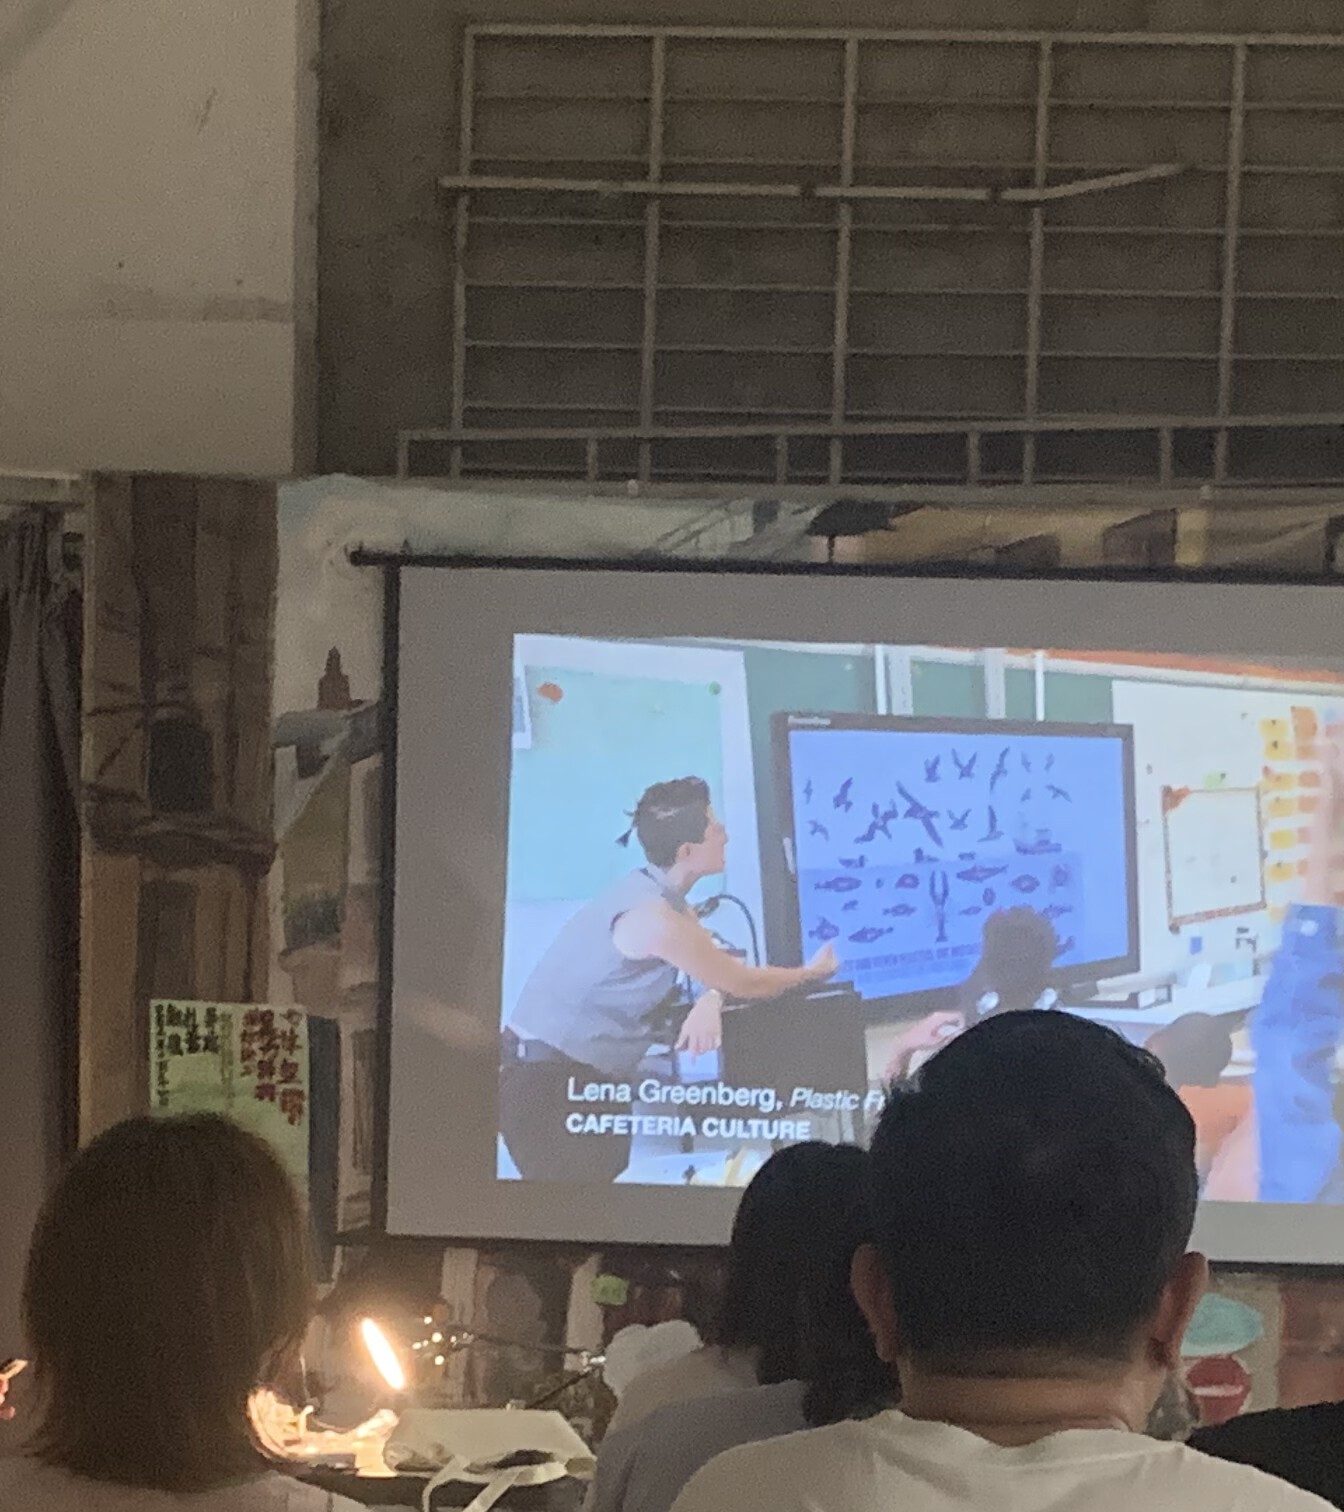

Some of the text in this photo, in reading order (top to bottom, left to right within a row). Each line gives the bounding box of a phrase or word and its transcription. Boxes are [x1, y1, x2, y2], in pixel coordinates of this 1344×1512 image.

[566, 1077, 631, 1103] Lena
[638, 1079, 783, 1111] Greenberg,
[790, 1087, 861, 1111] Plastic
[565, 1113, 811, 1141] CAFETERIA CULTURE
